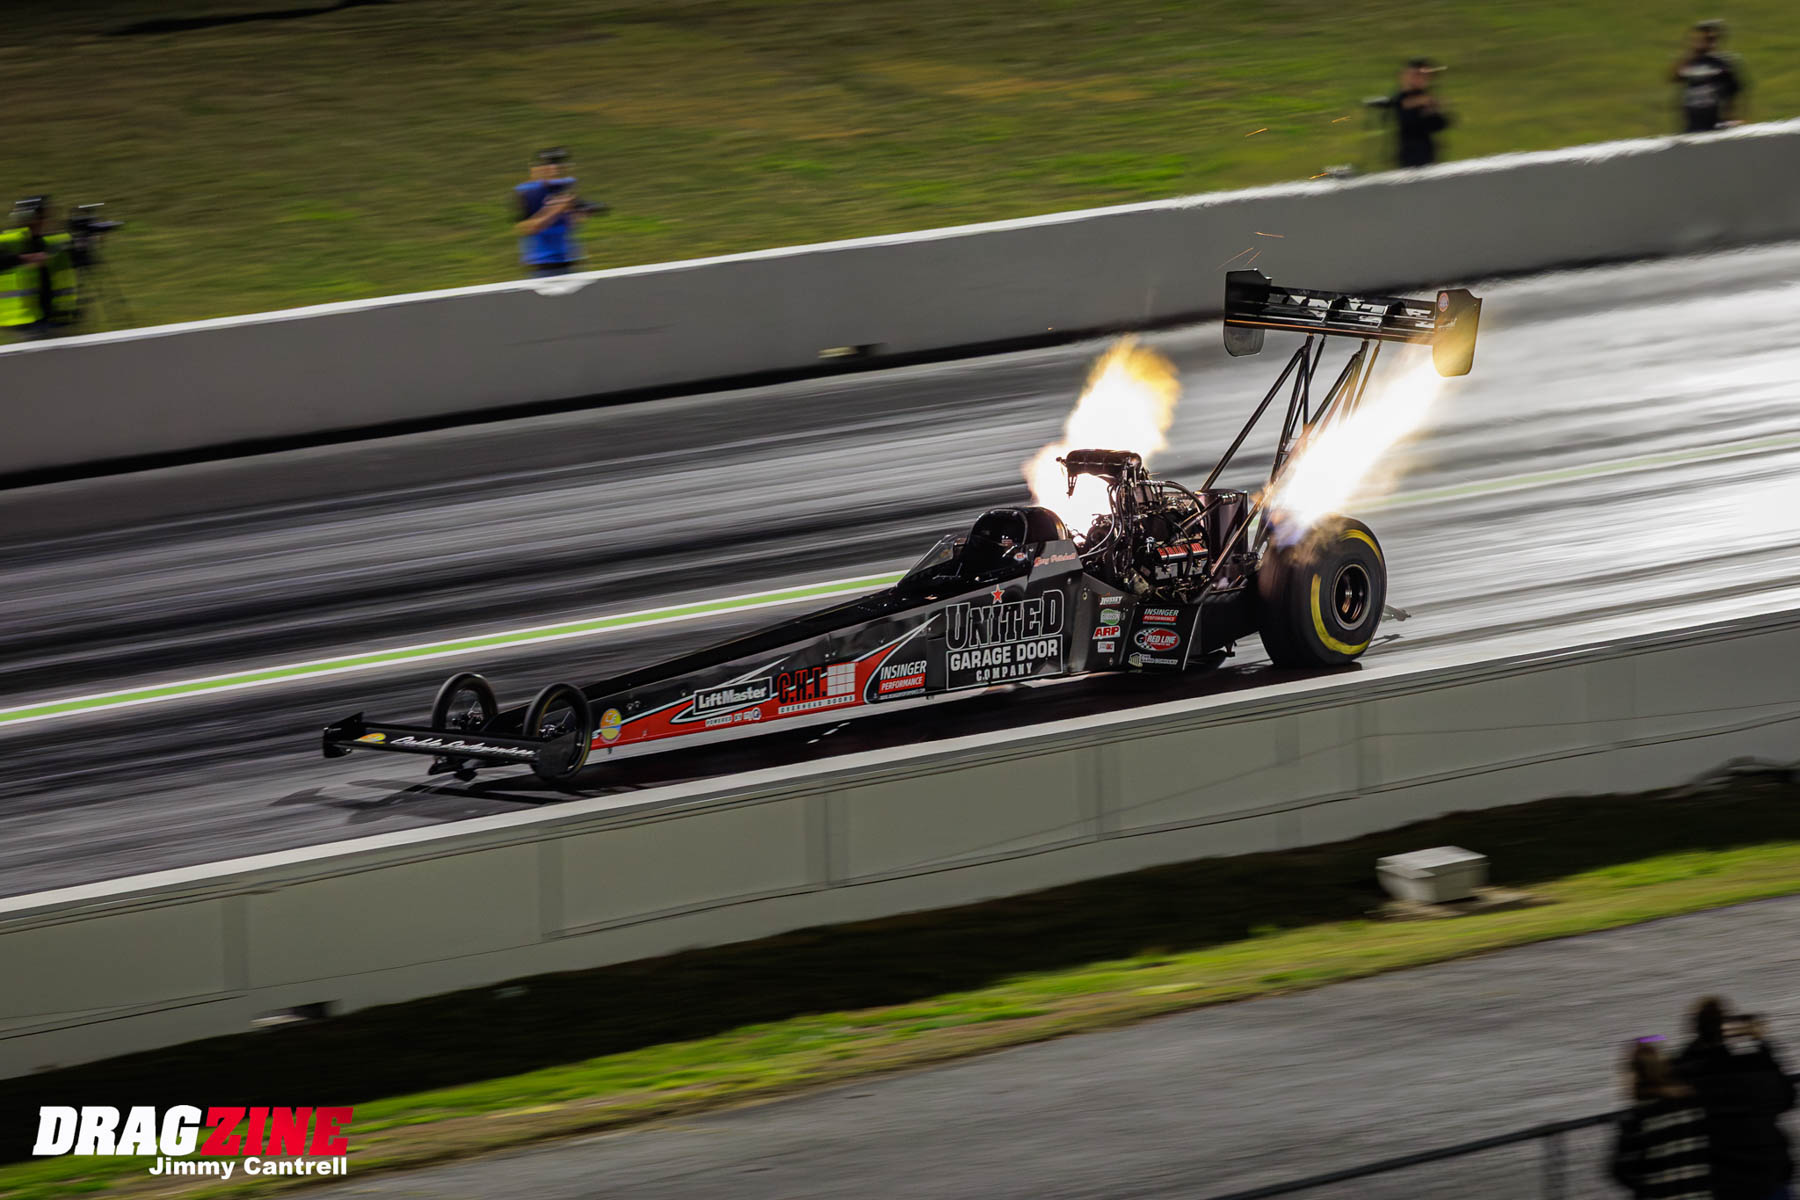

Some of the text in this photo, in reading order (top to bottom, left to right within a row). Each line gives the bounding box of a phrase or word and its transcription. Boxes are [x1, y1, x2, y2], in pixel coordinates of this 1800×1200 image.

[946, 589, 1064, 651] UNITED
[1144, 608, 1179, 616] INSINGER
[1094, 626, 1120, 638] ARP
[1146, 635, 1161, 643] RED
[1161, 636, 1177, 644] LINE
[950, 639, 1058, 671] GARAGE DOOR
[880, 660, 927, 680] INSINGER
[976, 662, 1032, 681] COMPANY
[881, 676, 923, 691] PERFORMANCE
[699, 686, 767, 709] LiftMaster
